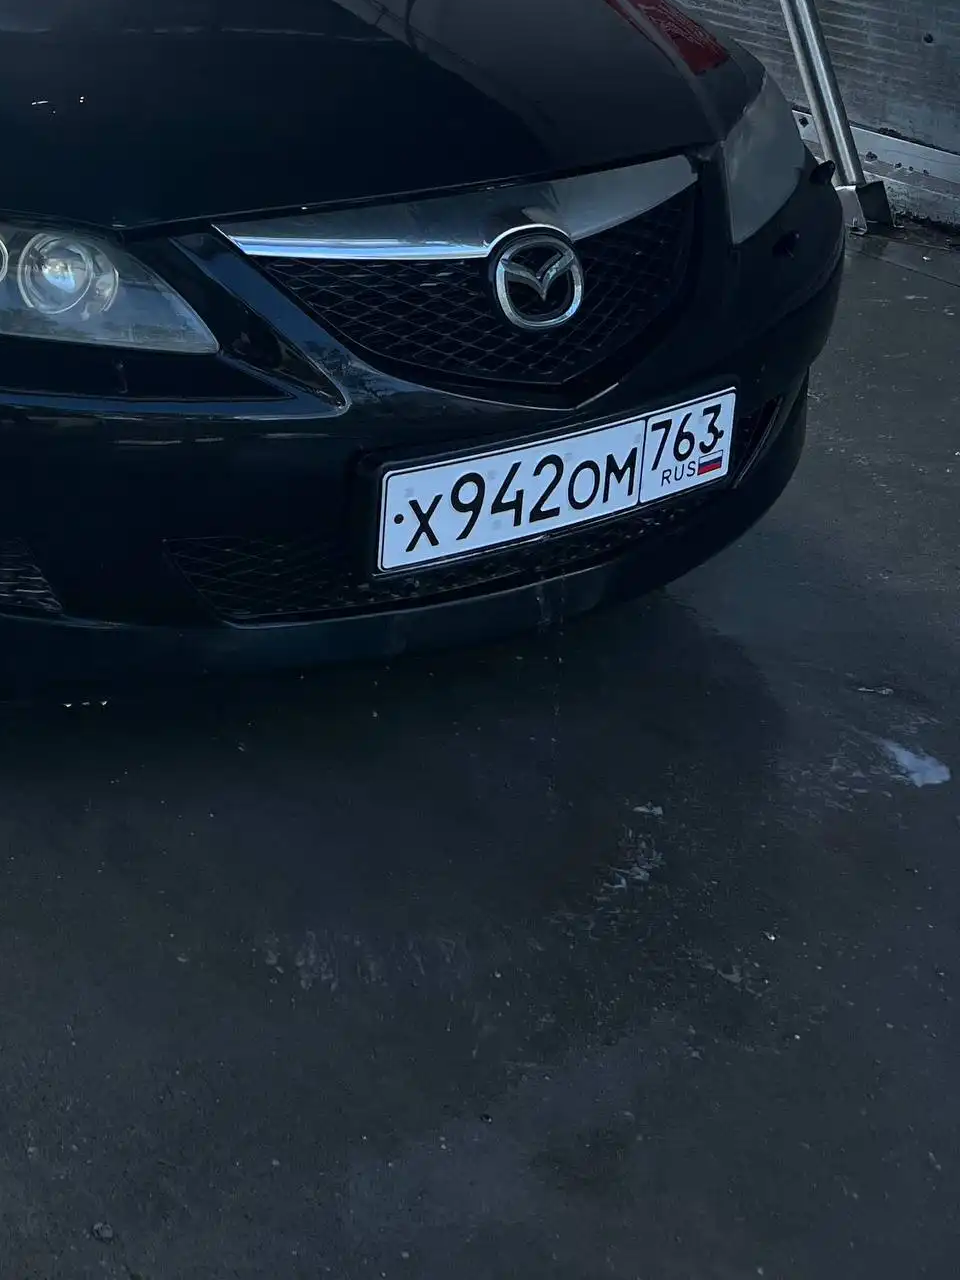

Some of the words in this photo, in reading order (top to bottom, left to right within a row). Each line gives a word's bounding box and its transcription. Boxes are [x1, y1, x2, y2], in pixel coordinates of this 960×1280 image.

[406, 447, 639, 552] Х942ОМ
[650, 404, 722, 471] 763
[661, 461, 696, 486] RUS
